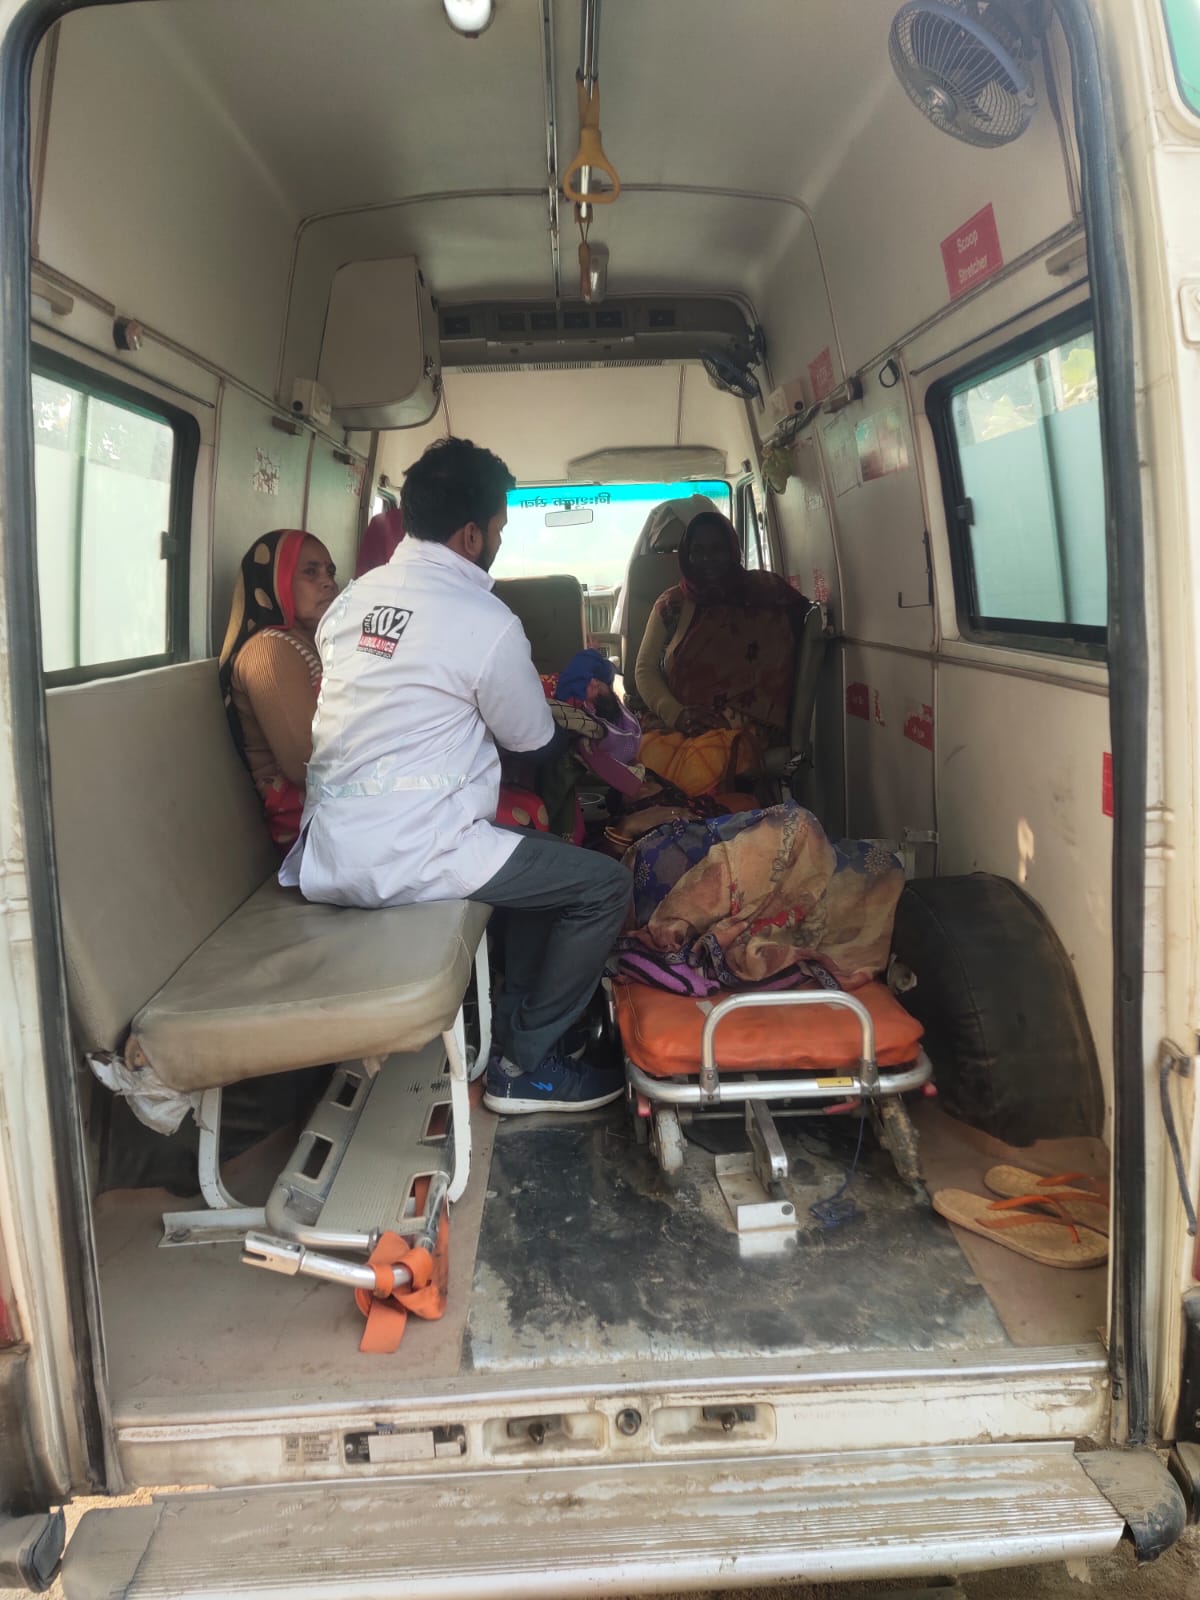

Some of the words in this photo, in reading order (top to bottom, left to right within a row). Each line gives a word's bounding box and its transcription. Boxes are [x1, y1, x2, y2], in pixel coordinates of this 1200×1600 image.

[956, 229, 978, 253] Scoop
[958, 254, 988, 284] Stretcher
[371, 607, 410, 639] 102
[359, 636, 396, 653] AMBULANCE
